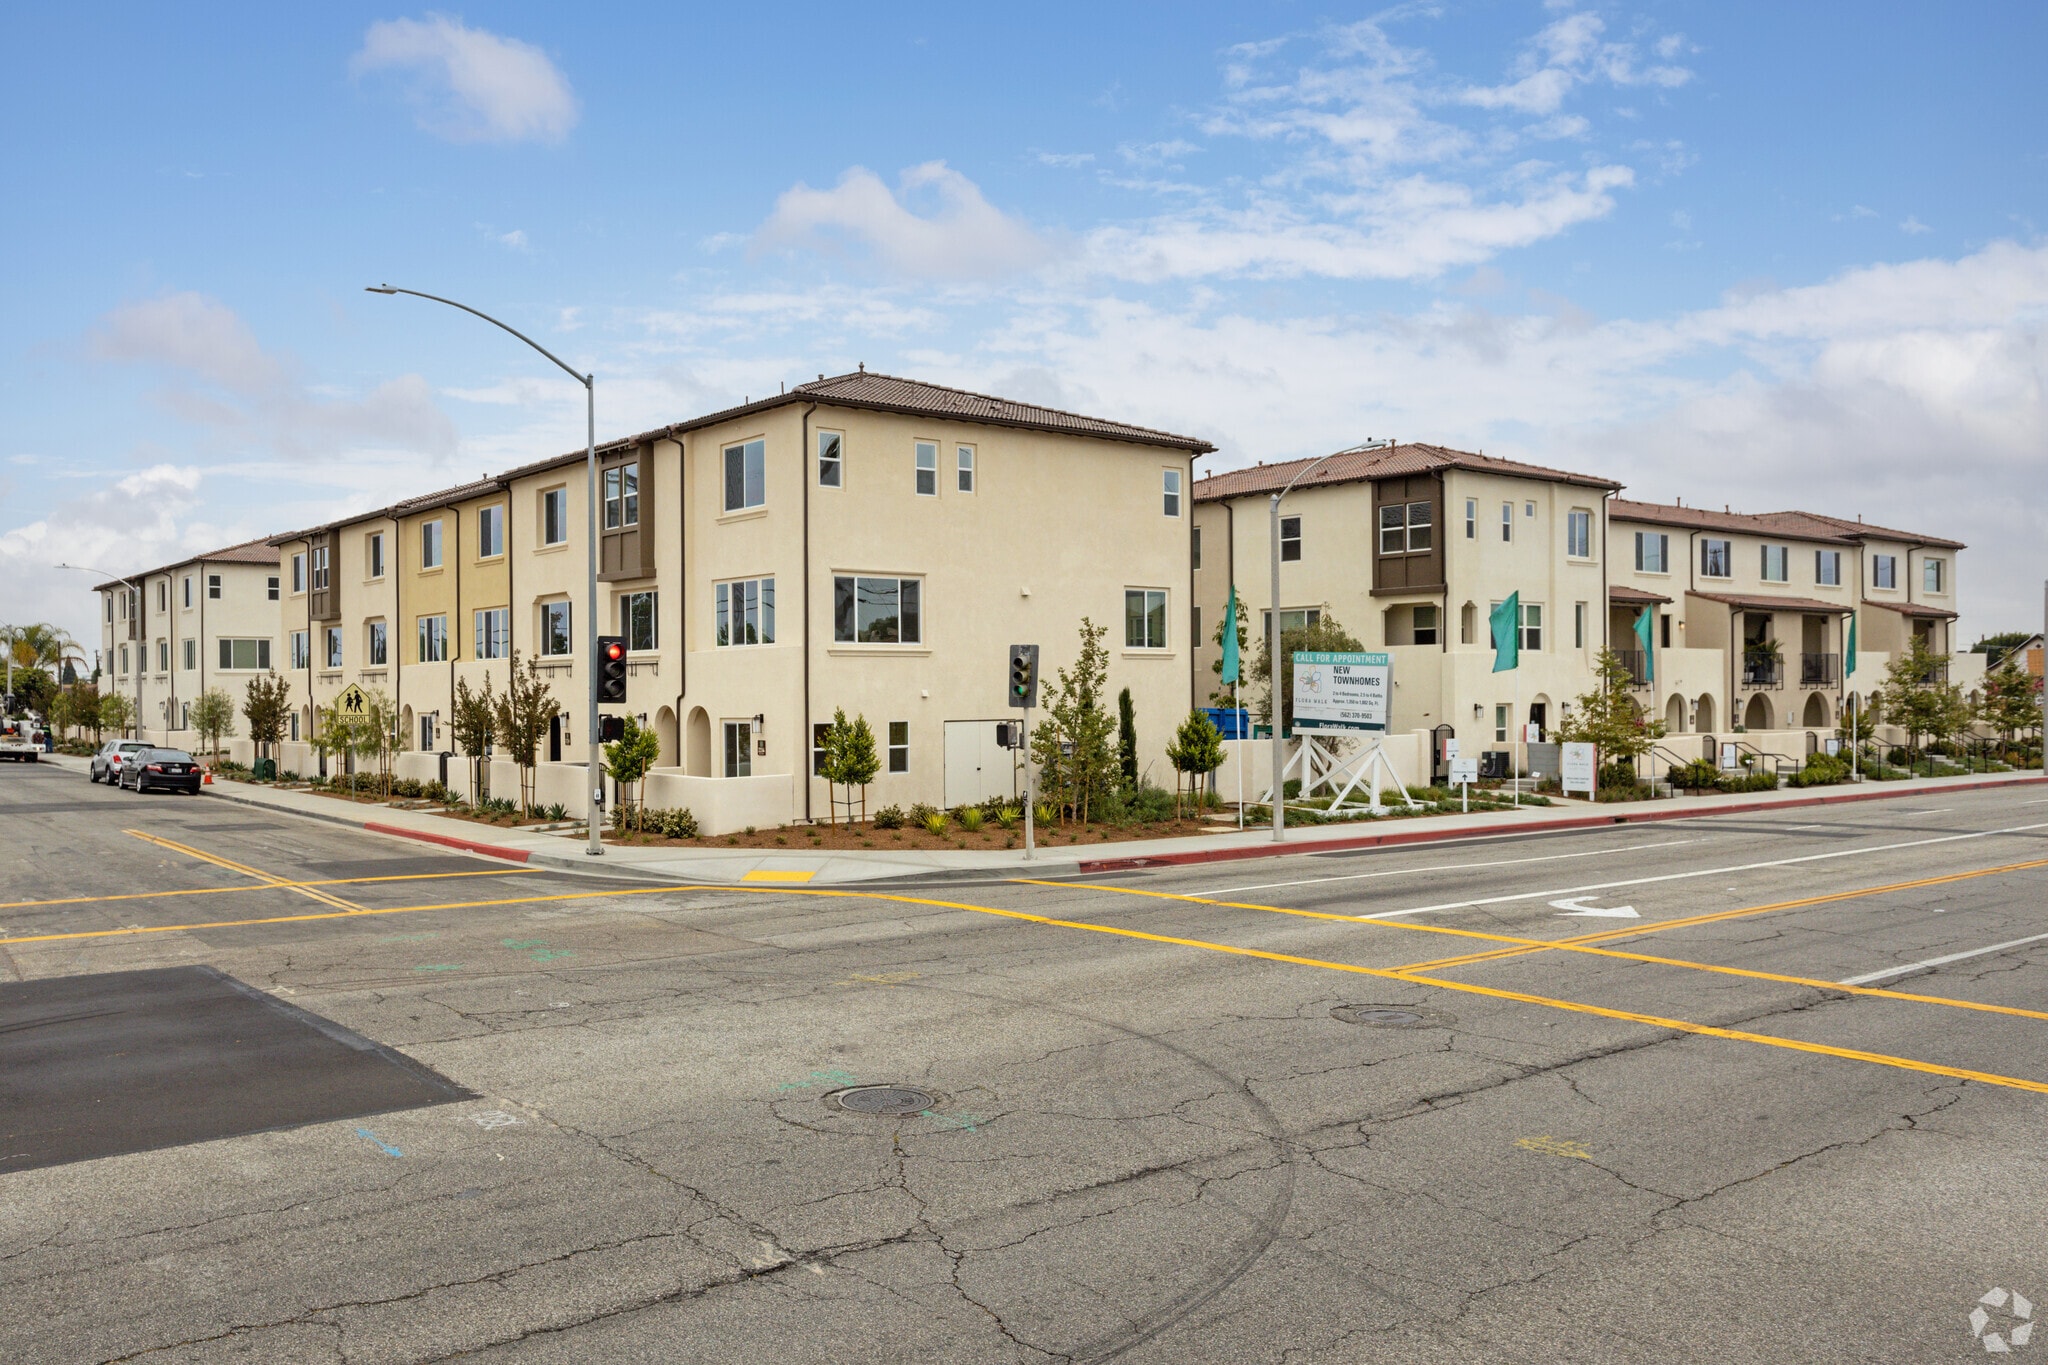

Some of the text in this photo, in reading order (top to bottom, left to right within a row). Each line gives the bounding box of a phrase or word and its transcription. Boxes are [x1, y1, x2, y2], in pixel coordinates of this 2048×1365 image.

[1296, 654, 1386, 664] CALL FOR APPOINTMENT
[1333, 666, 1350, 674] NEW
[1333, 676, 1380, 686] TOWNHOMES
